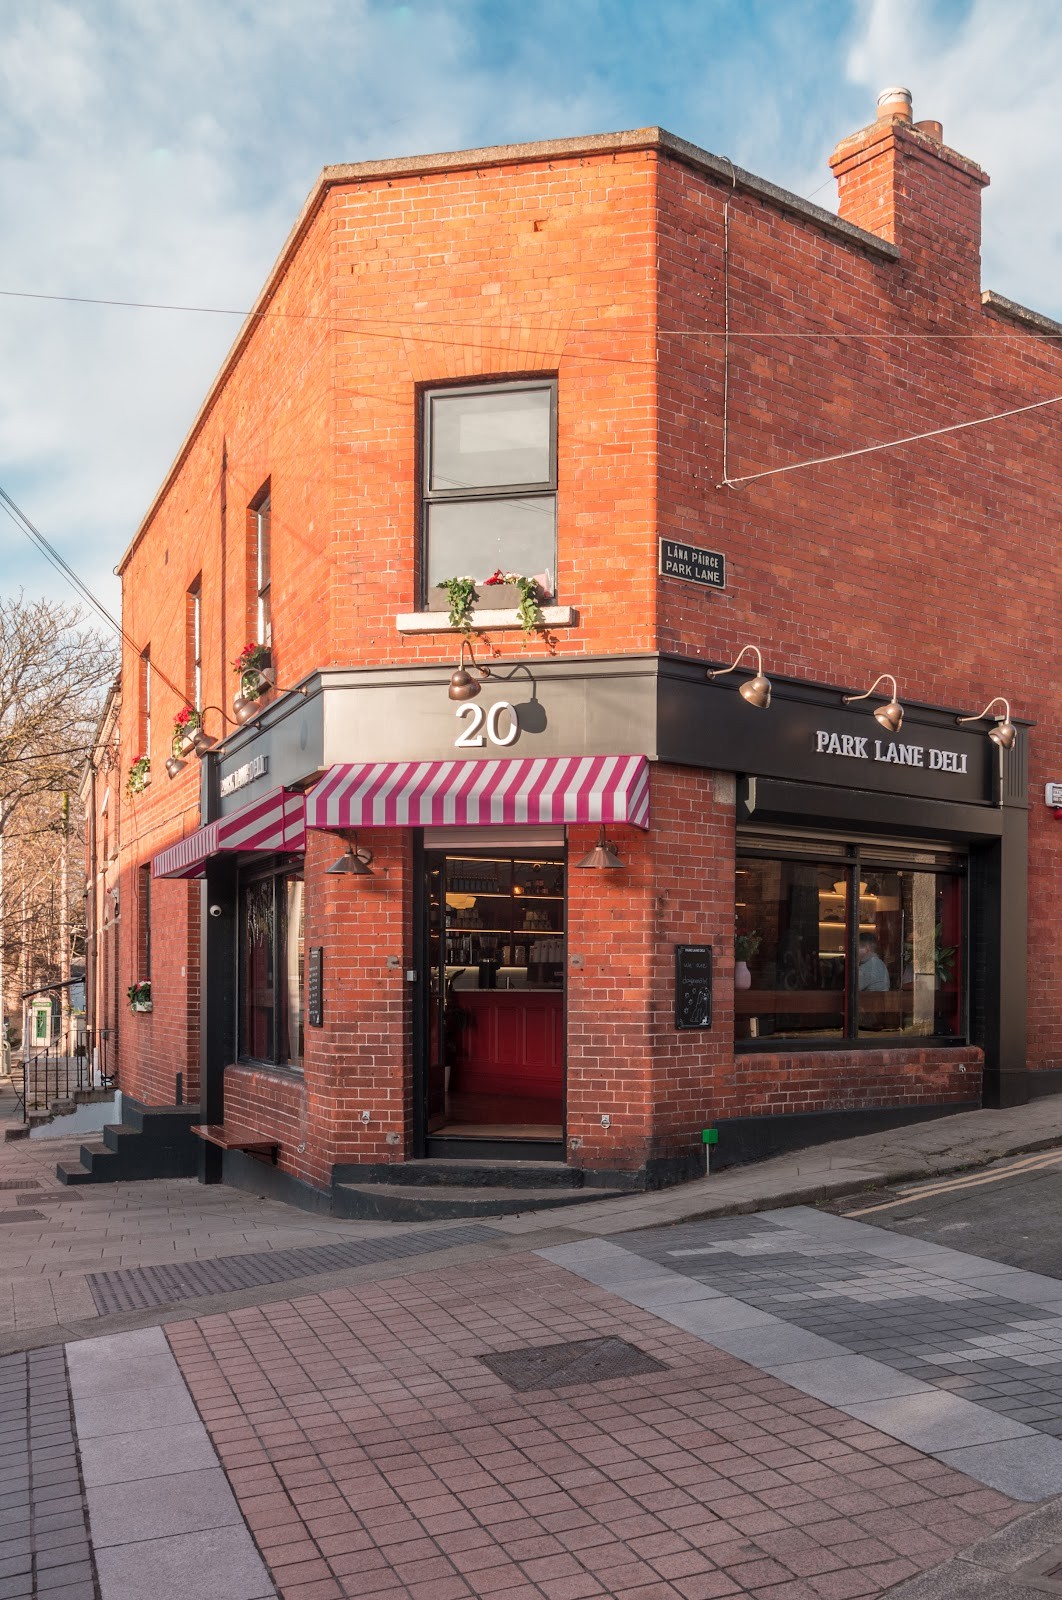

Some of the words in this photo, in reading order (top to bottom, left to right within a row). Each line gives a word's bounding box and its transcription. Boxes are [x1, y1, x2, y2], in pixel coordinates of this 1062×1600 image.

[666, 560, 692, 577] PARK
[695, 567, 720, 583] LANE
[667, 545, 688, 561] LÁNA
[691, 551, 719, 569] PÁIRCE
[454, 701, 518, 747] 20
[816, 730, 868, 759] PARK
[874, 740, 924, 767] LANE
[928, 748, 968, 774] DELI
